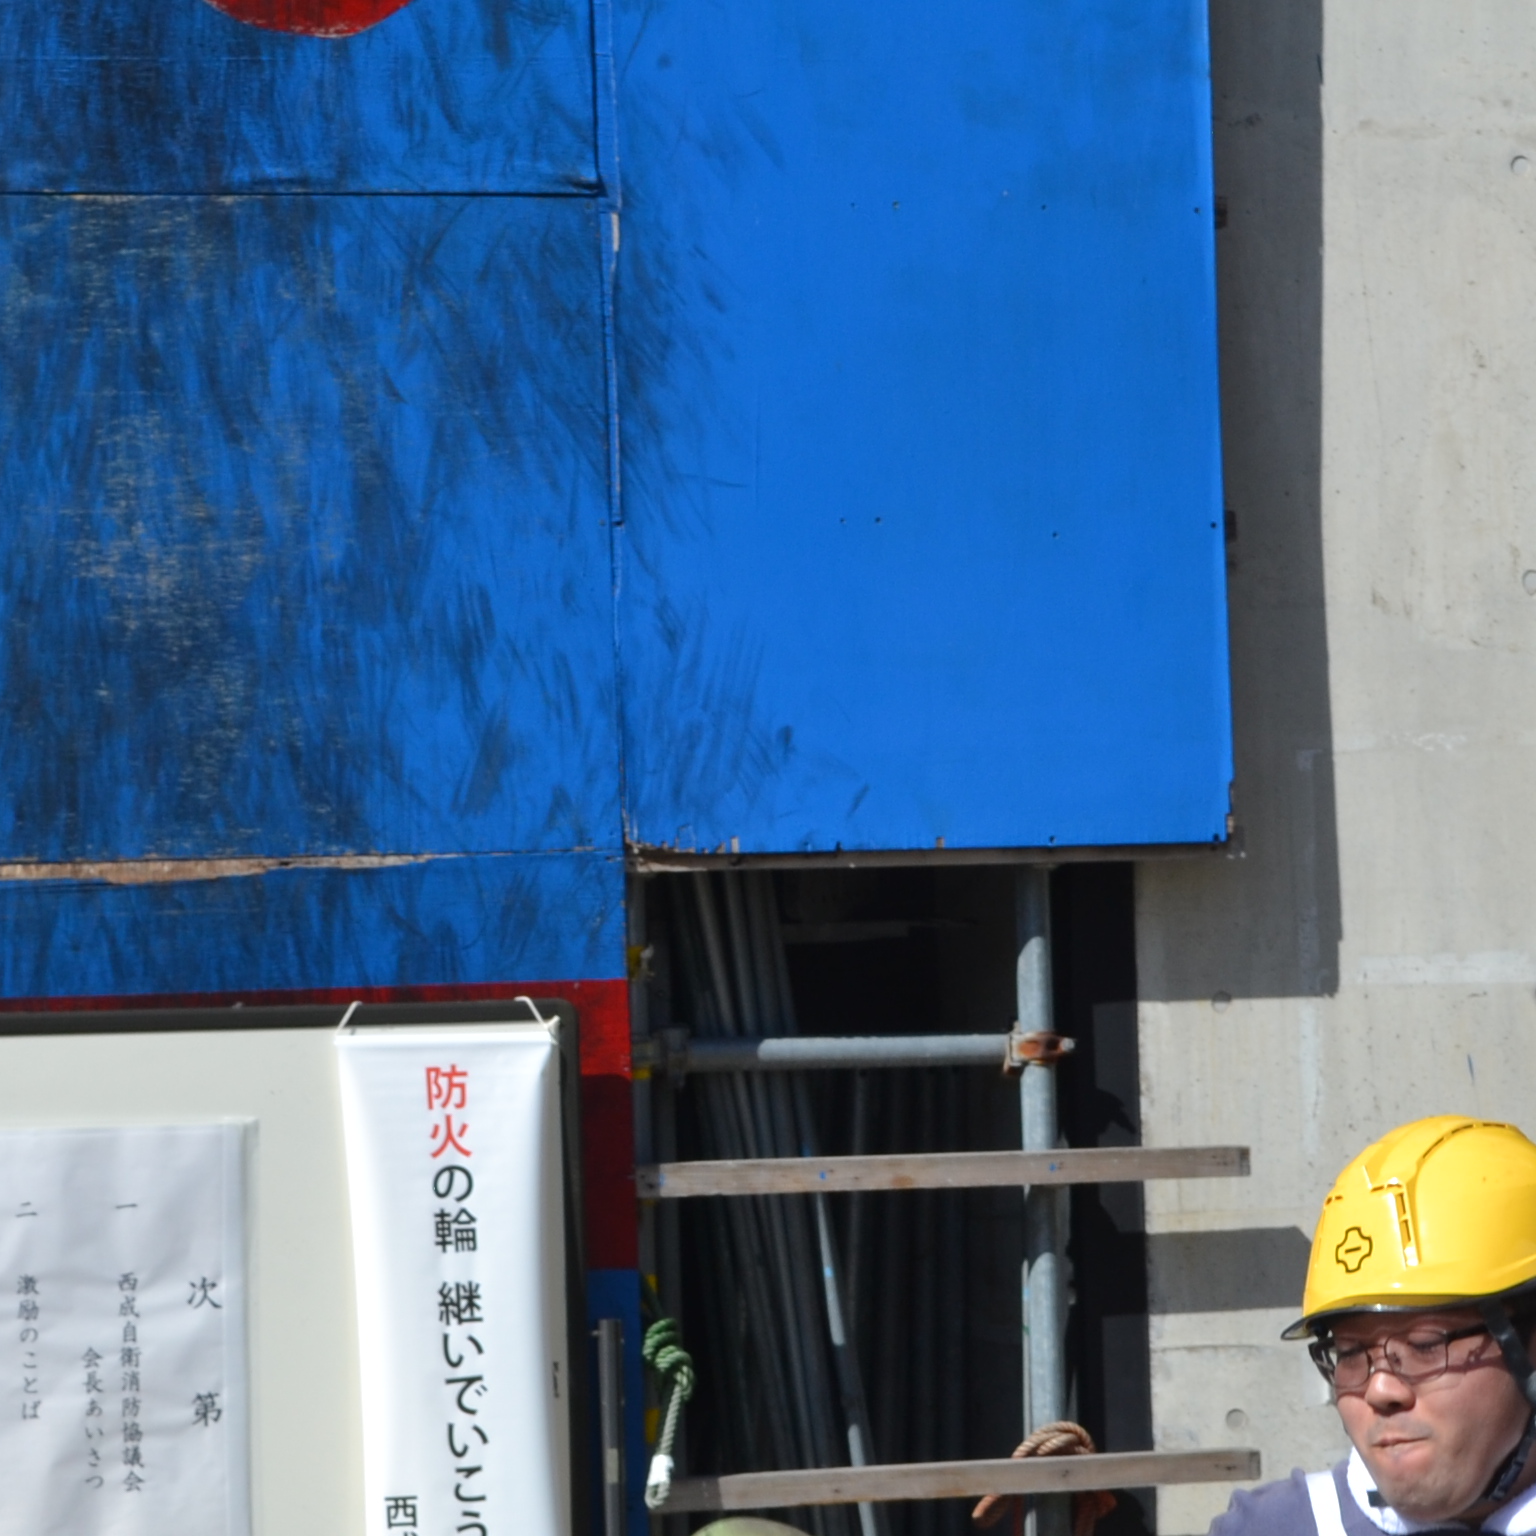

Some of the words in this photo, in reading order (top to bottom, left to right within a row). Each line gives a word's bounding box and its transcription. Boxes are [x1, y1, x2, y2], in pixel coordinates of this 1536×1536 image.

[425, 1065, 477, 1254] 防火の輪
[16, 1275, 41, 1420] 激励のことば
[81, 1347, 105, 1490] 会長あいさつ
[117, 1272, 145, 1492] 西成自衛消防協議会
